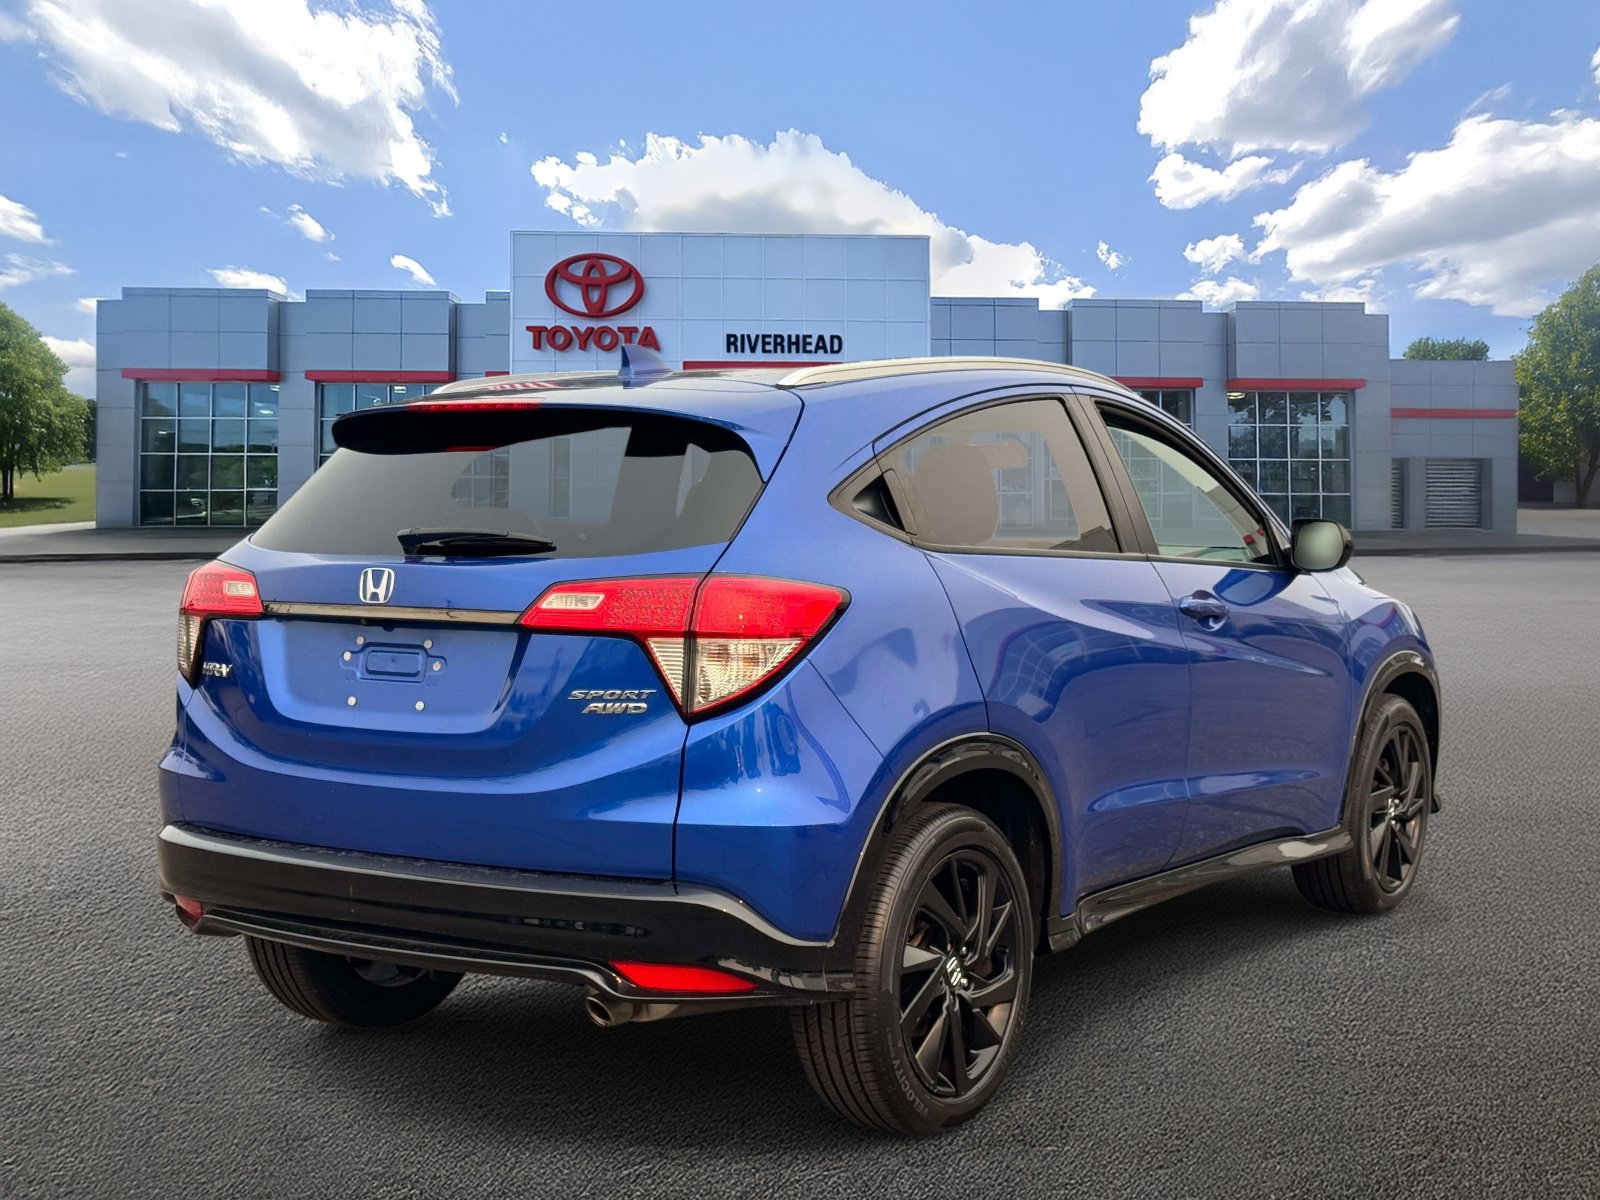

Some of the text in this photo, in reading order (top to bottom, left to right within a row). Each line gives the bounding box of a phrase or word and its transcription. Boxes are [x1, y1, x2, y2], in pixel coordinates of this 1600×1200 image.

[526, 326, 661, 352] TOYOTA
[726, 333, 843, 354] RIVERHEAD
[567, 689, 657, 700] SPORT
[581, 702, 648, 714] AWD
[892, 1059, 929, 1119] VELOCITY
